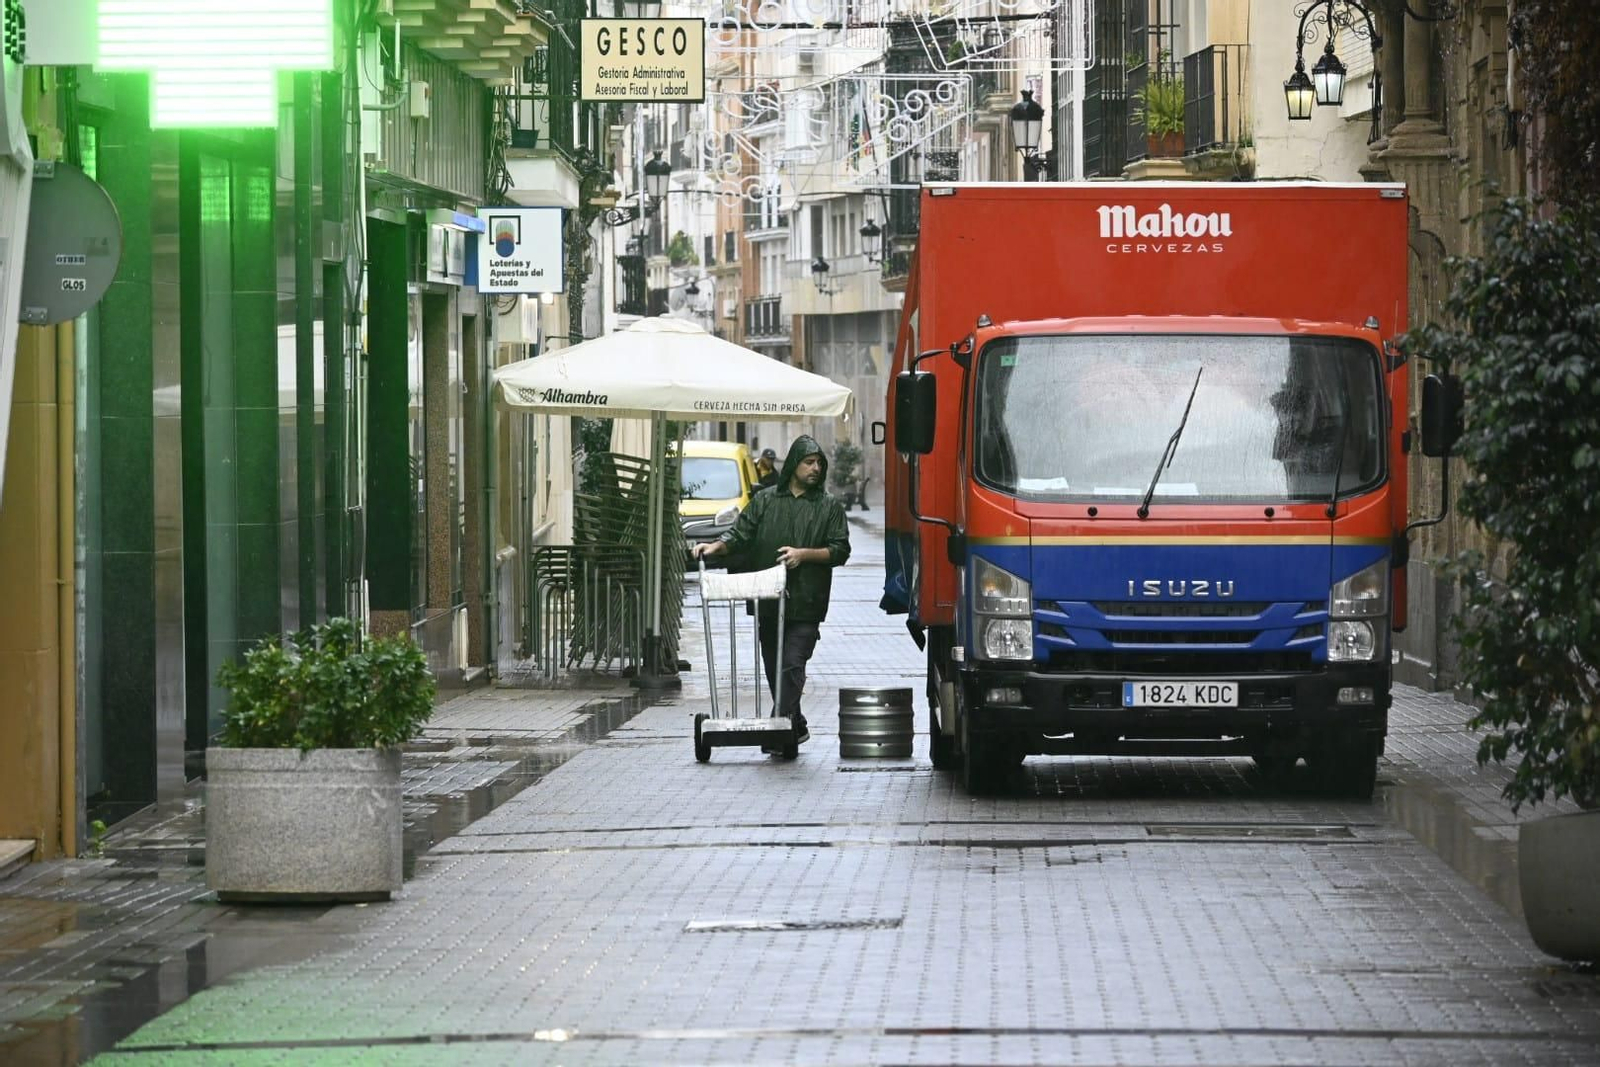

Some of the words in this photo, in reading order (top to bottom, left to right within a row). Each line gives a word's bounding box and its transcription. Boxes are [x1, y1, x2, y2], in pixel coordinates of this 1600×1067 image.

[597, 26, 687, 56] GESCO
[598, 66, 629, 79] Gestoria
[632, 66, 685, 79] Administrativa
[595, 83, 627, 95] Asesoria
[629, 82, 649, 95] Fiscal
[652, 86, 658, 98] y
[660, 81, 688, 95] Laboral
[1096, 203, 1233, 238] Mahou
[1106, 243, 1224, 253] CERVEZAS
[525, 260, 531, 269] y
[490, 269, 529, 278] Apuestas
[531, 269, 544, 277] del
[62, 280, 85, 290] GLOS
[489, 278, 519, 287] Estado
[540, 388, 608, 405] Alhambra
[693, 401, 730, 410] CERVEZA
[732, 402, 760, 411] HECHA
[762, 402, 777, 411] SIN
[780, 403, 806, 412] PRISA
[1128, 580, 1234, 596] ISUZU
[1140, 685, 1187, 703] 1824
[1195, 685, 1233, 703] KDC
